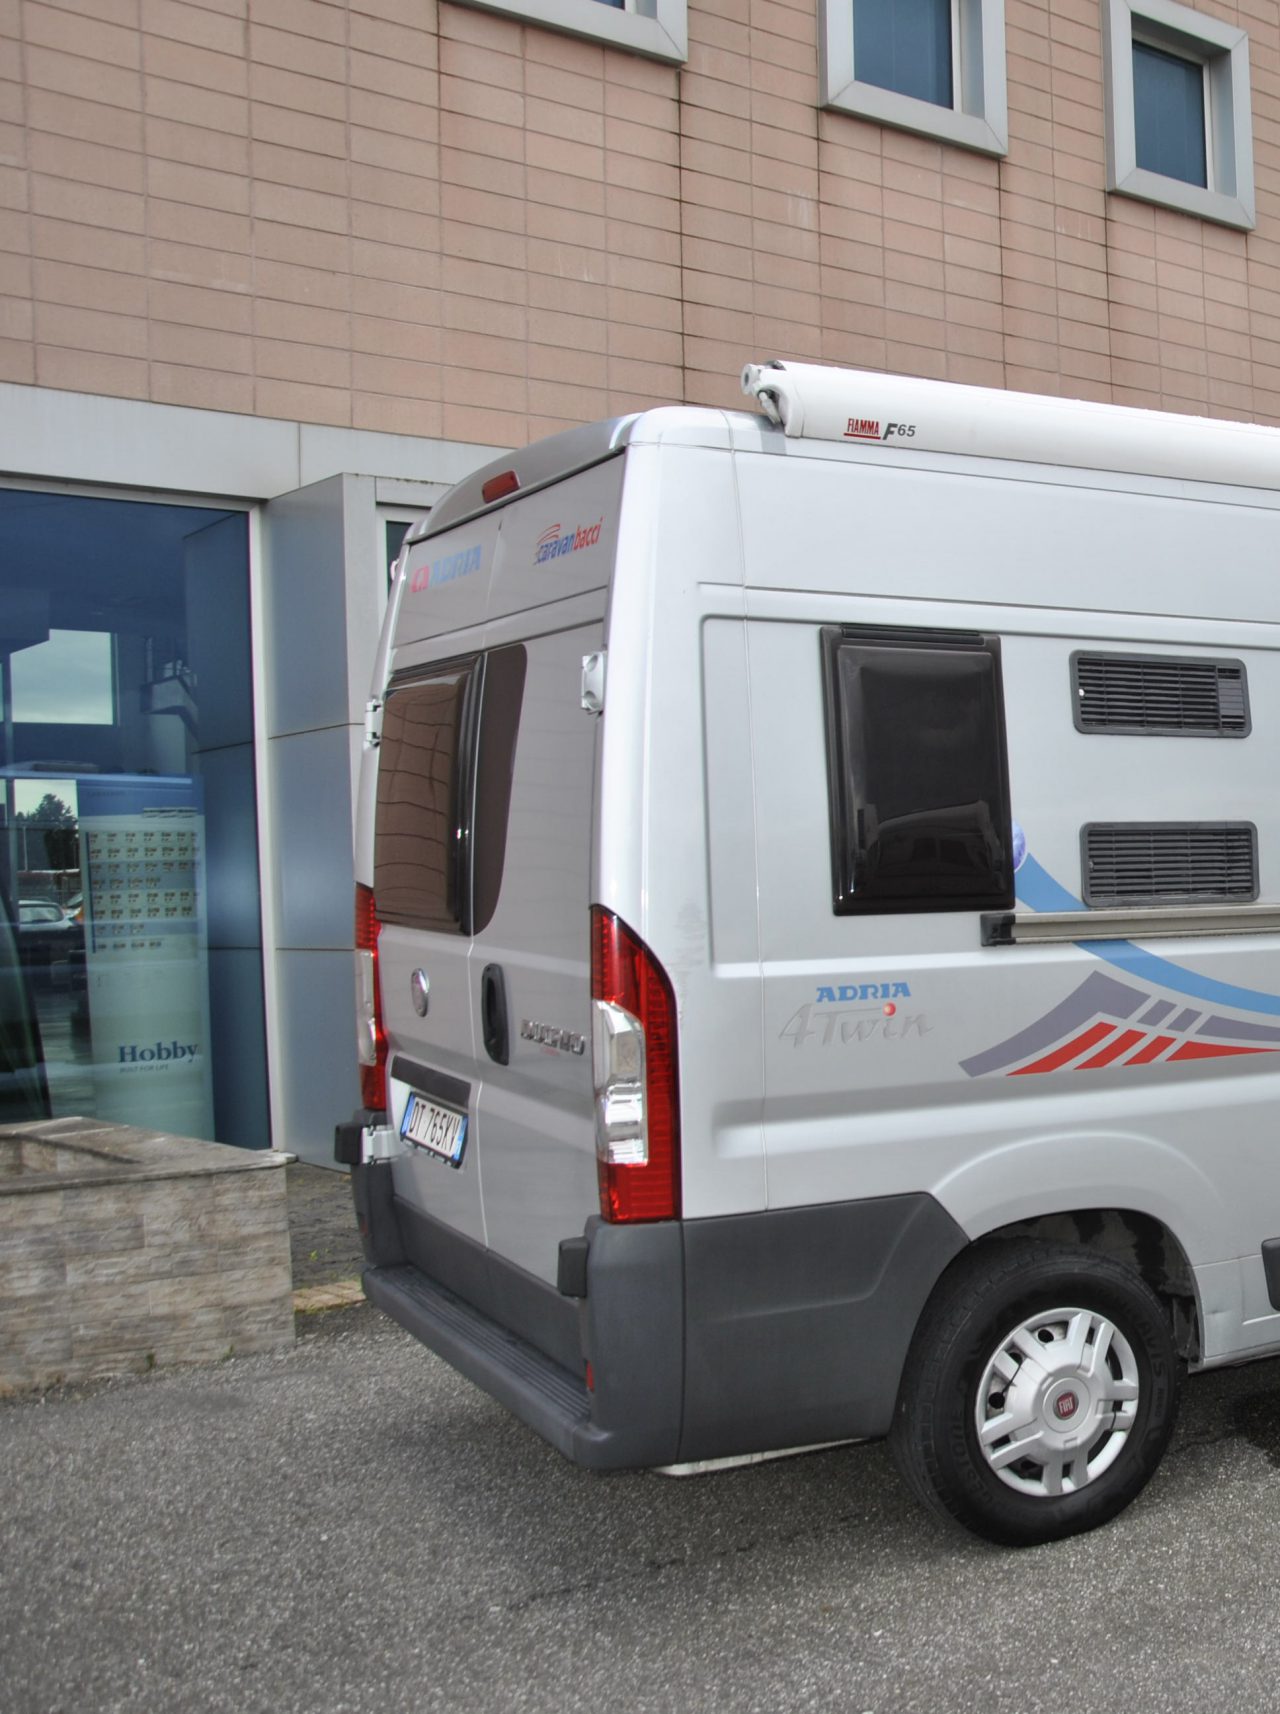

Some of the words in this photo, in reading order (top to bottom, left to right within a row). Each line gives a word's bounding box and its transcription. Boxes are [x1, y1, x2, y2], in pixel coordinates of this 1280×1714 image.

[846, 418, 880, 436] FIAMMA
[882, 423, 916, 440] F65
[816, 982, 912, 1003] ADRIA
[118, 1040, 199, 1064] Hobby
[1059, 1396, 1073, 1414] FIAT
